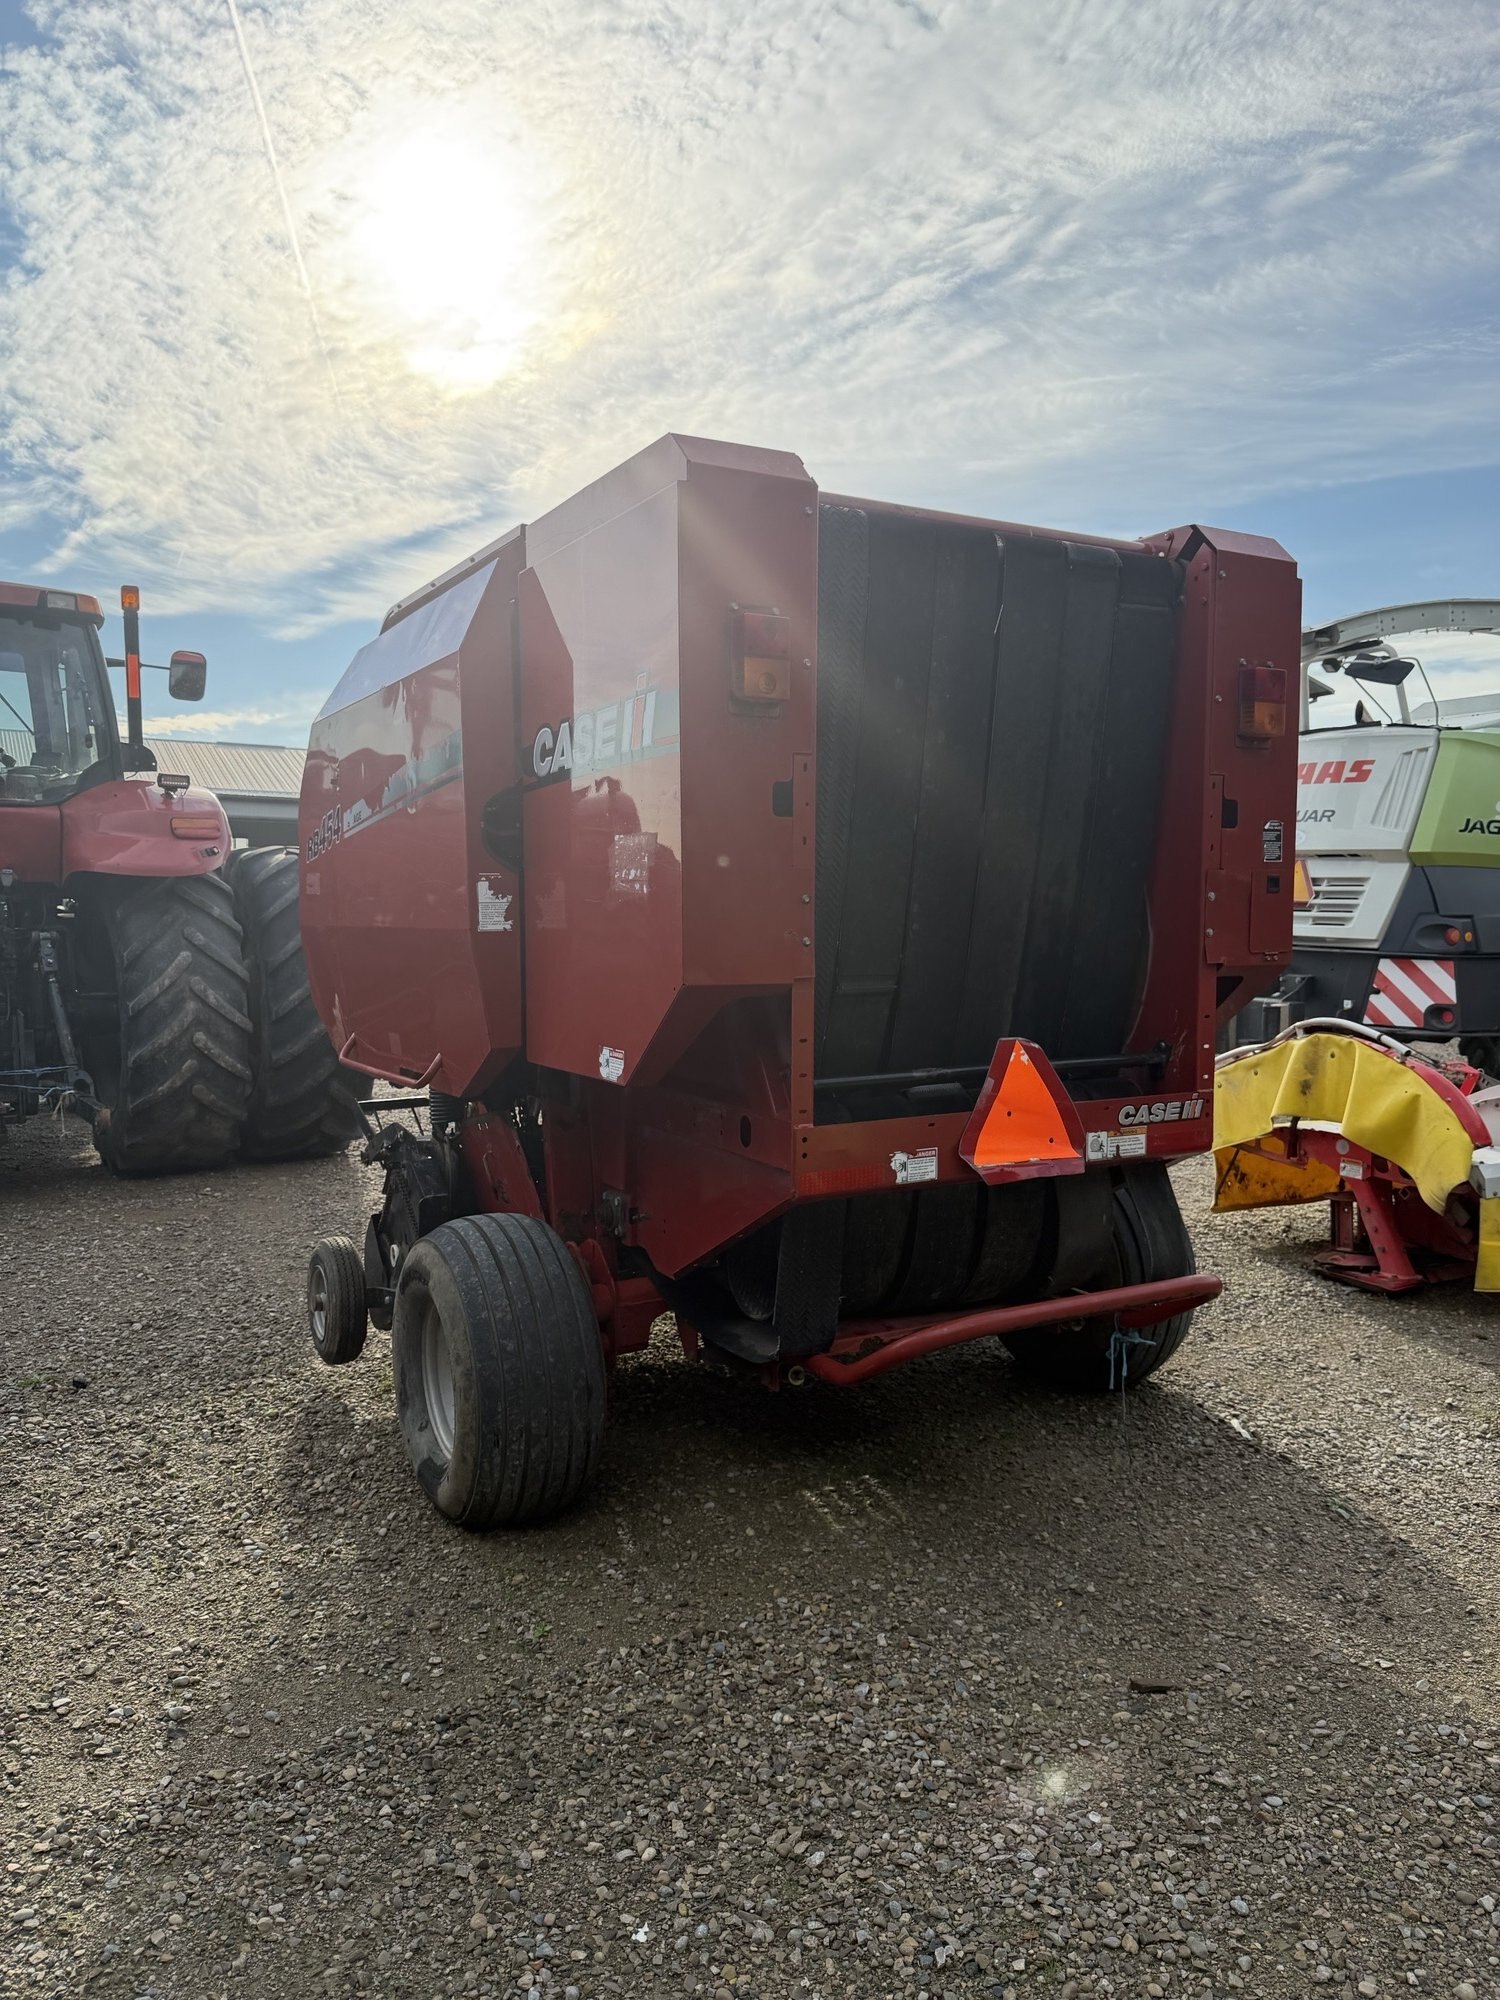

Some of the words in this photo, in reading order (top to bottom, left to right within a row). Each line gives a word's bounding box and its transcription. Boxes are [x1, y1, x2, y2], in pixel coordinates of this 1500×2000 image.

[532, 705, 618, 777] CASE
[306, 804, 341, 864] RB454
[1458, 818, 1500, 835] JAG
[1118, 1101, 1181, 1126] CASE
[914, 1150, 936, 1158] ANGER
